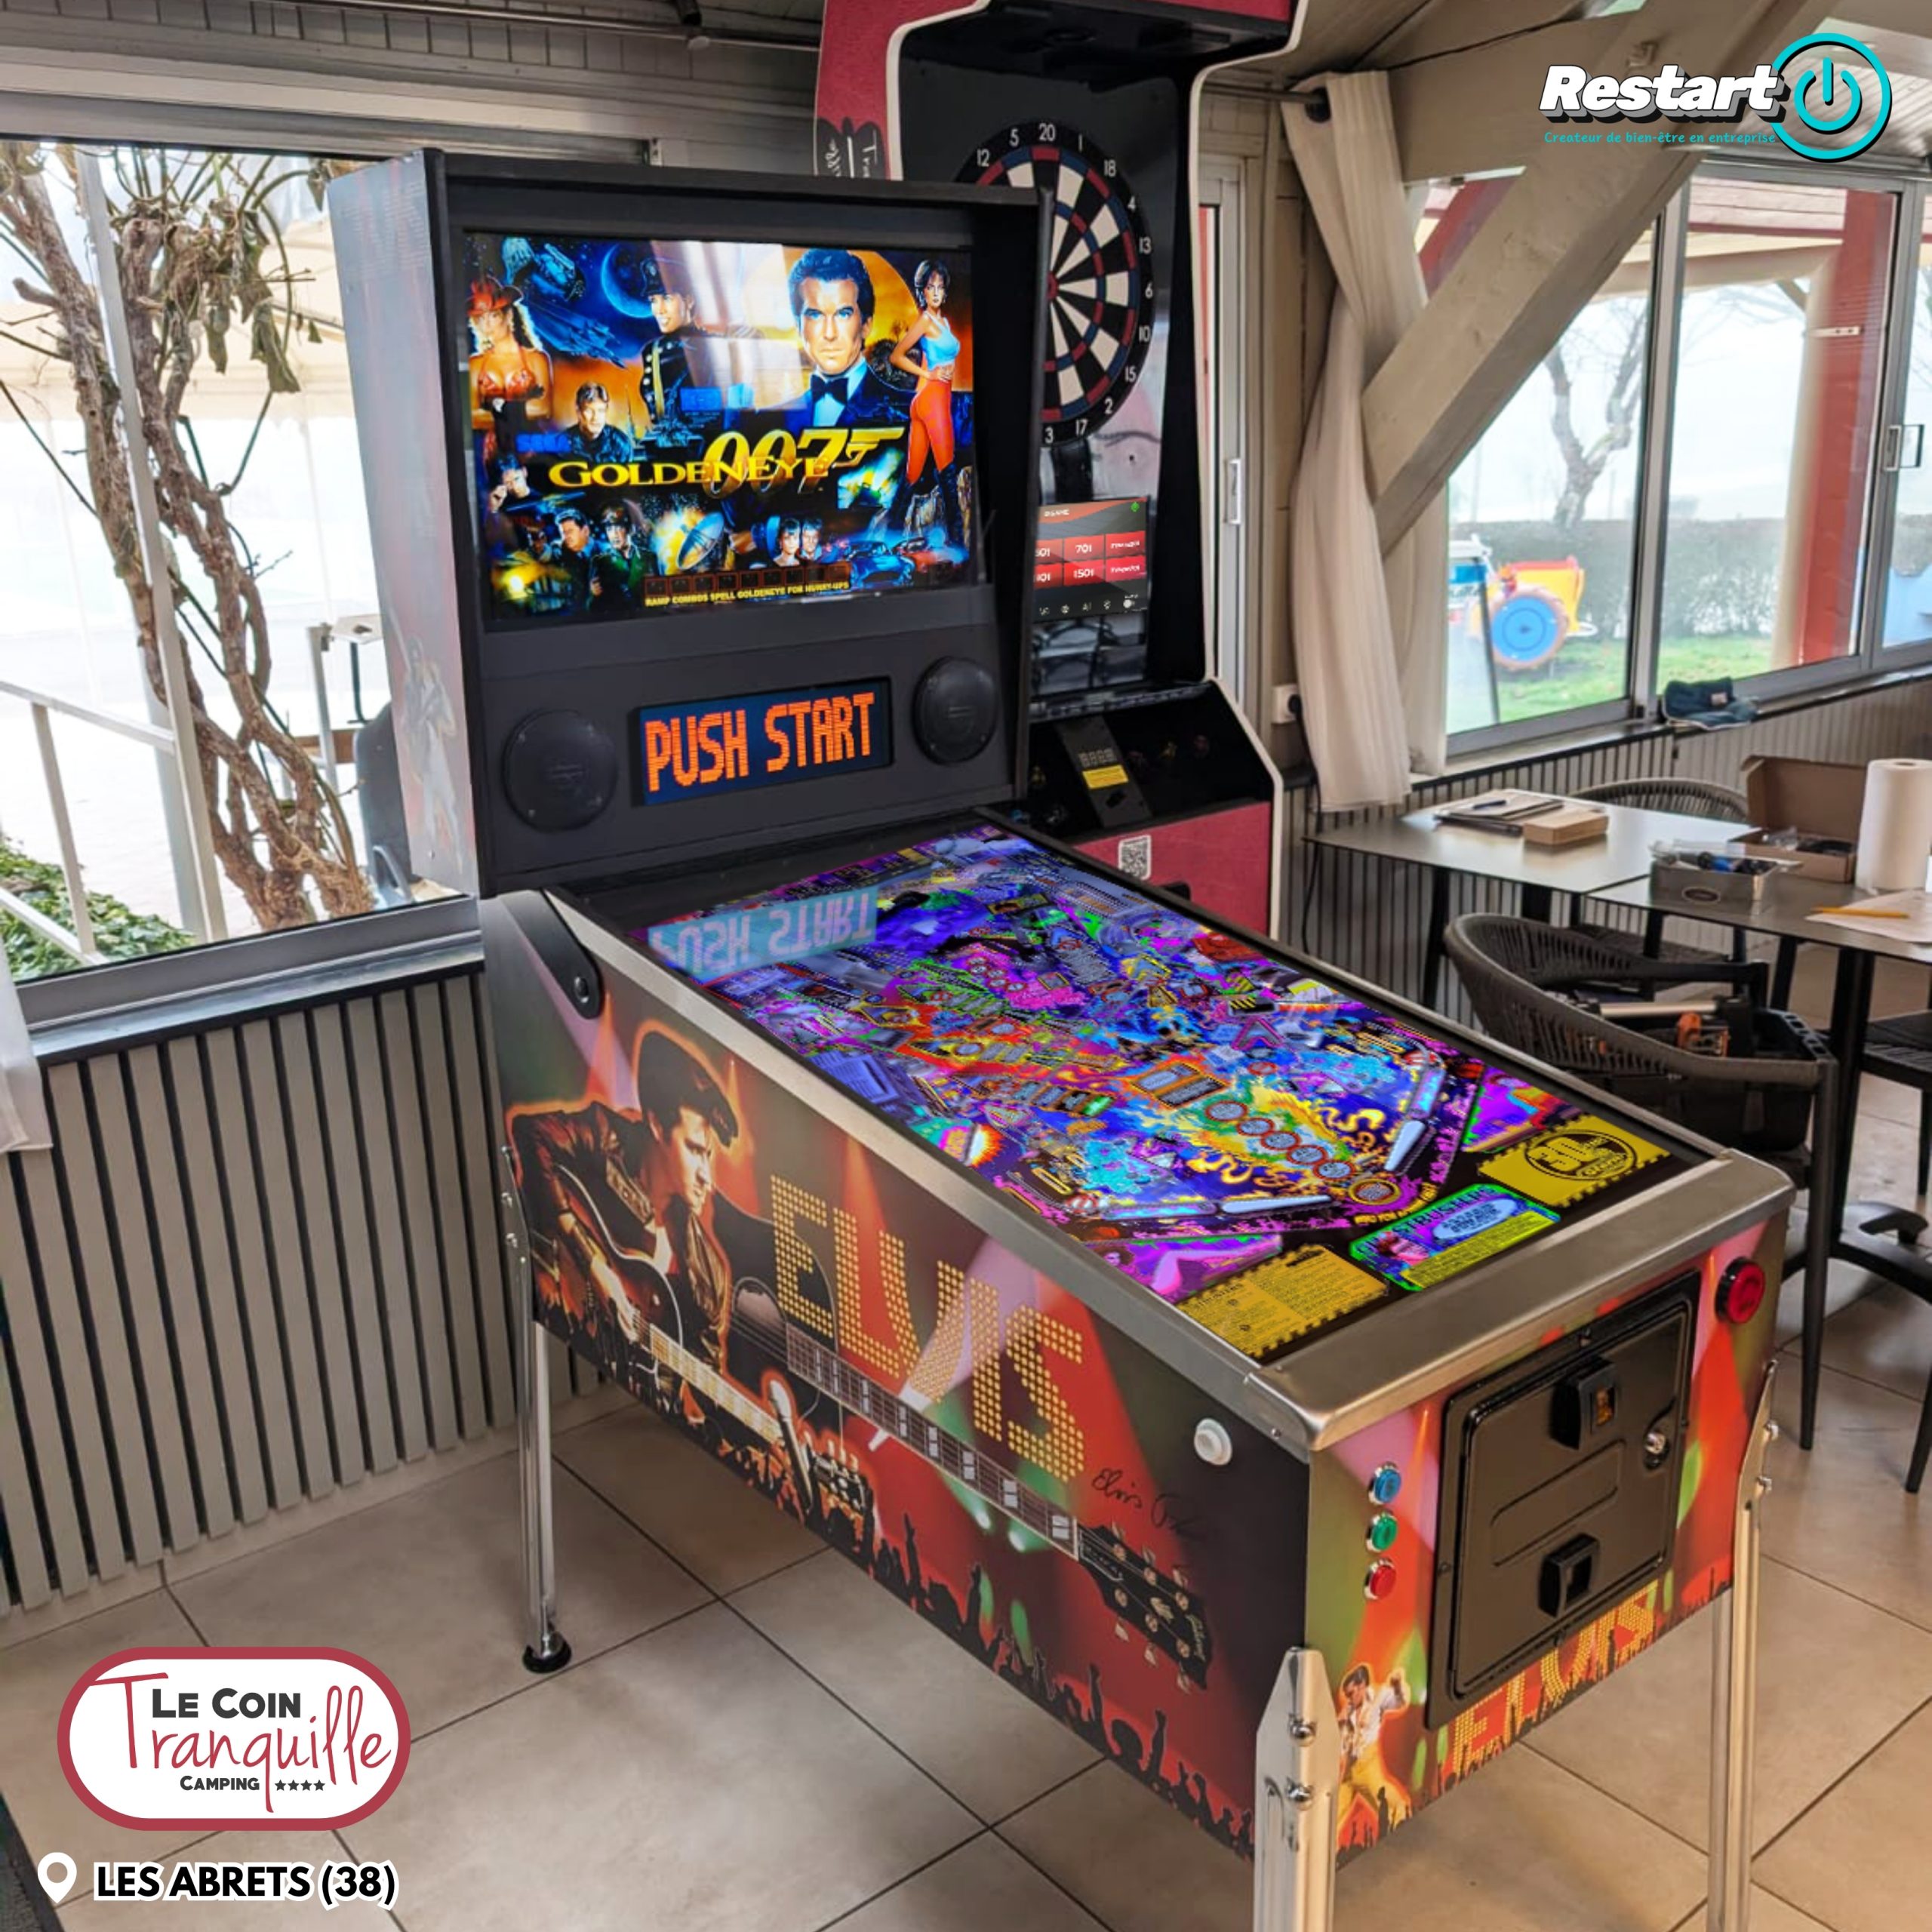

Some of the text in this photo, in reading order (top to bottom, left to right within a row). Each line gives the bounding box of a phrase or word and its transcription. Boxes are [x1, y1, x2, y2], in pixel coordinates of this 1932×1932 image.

[1010, 129, 1020, 146] 5
[1038, 123, 1056, 142] 20
[1078, 134, 1084, 150] 1
[977, 149, 990, 167] 12
[1103, 160, 1117, 177] 18
[1128, 195, 1137, 211] 4
[1138, 237, 1152, 254] 13
[1145, 282, 1153, 298] 6
[1138, 325, 1152, 343] 10
[1124, 365, 1137, 382] 15
[1103, 398, 1115, 414] 2
[1044, 426, 1054, 444] 3
[1075, 419, 1088, 437] 17
[549, 454, 829, 488] GOLDENEYE
[701, 427, 904, 499] 007
[1075, 544, 1092, 553] 701
[645, 691, 875, 792] PUSH START
[771, 1174, 1085, 1484] ELVIS
